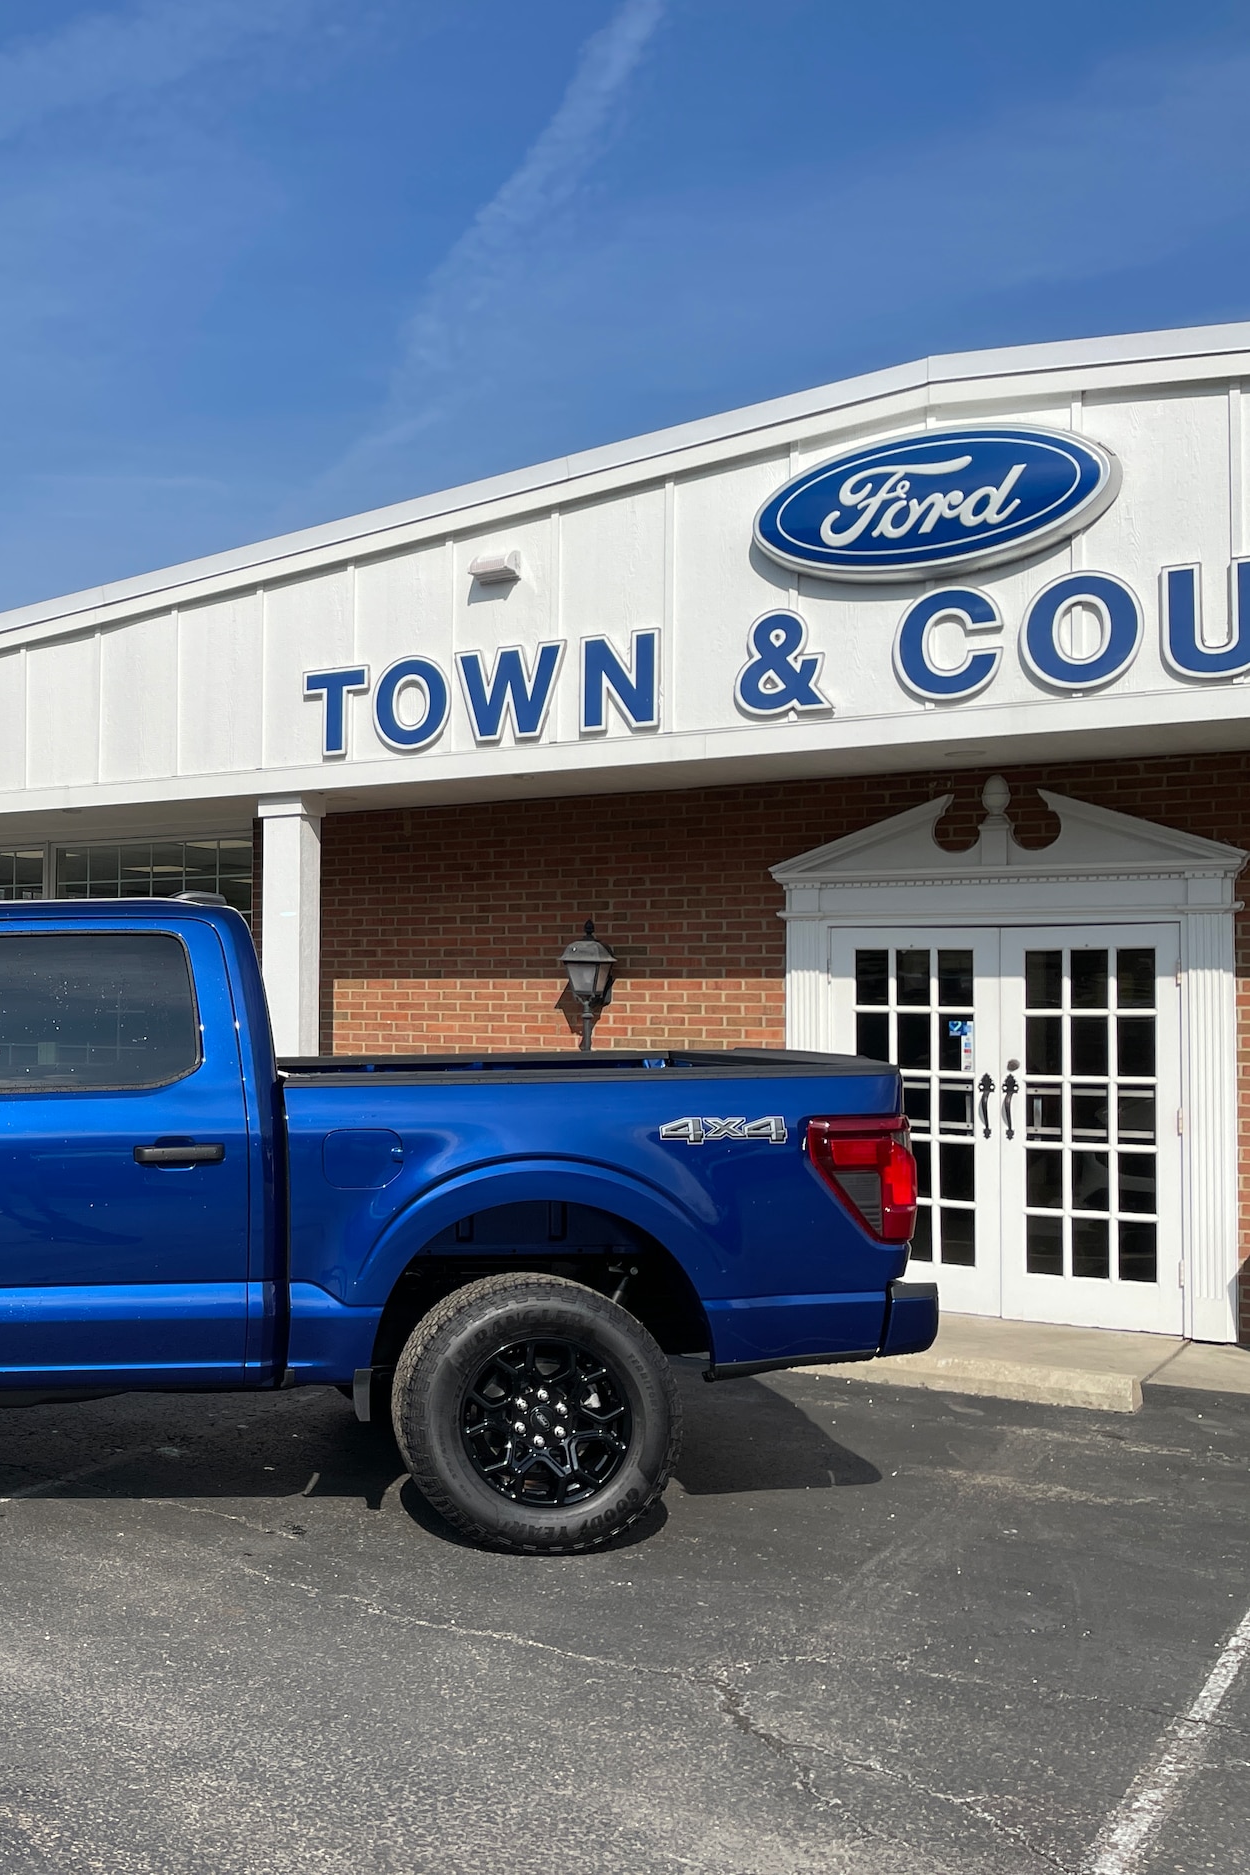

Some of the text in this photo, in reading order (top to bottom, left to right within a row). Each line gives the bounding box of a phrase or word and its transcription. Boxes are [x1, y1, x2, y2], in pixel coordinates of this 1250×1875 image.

[819, 455, 1027, 547] Ford
[304, 630, 659, 755] TOWN
[737, 611, 833, 713] &
